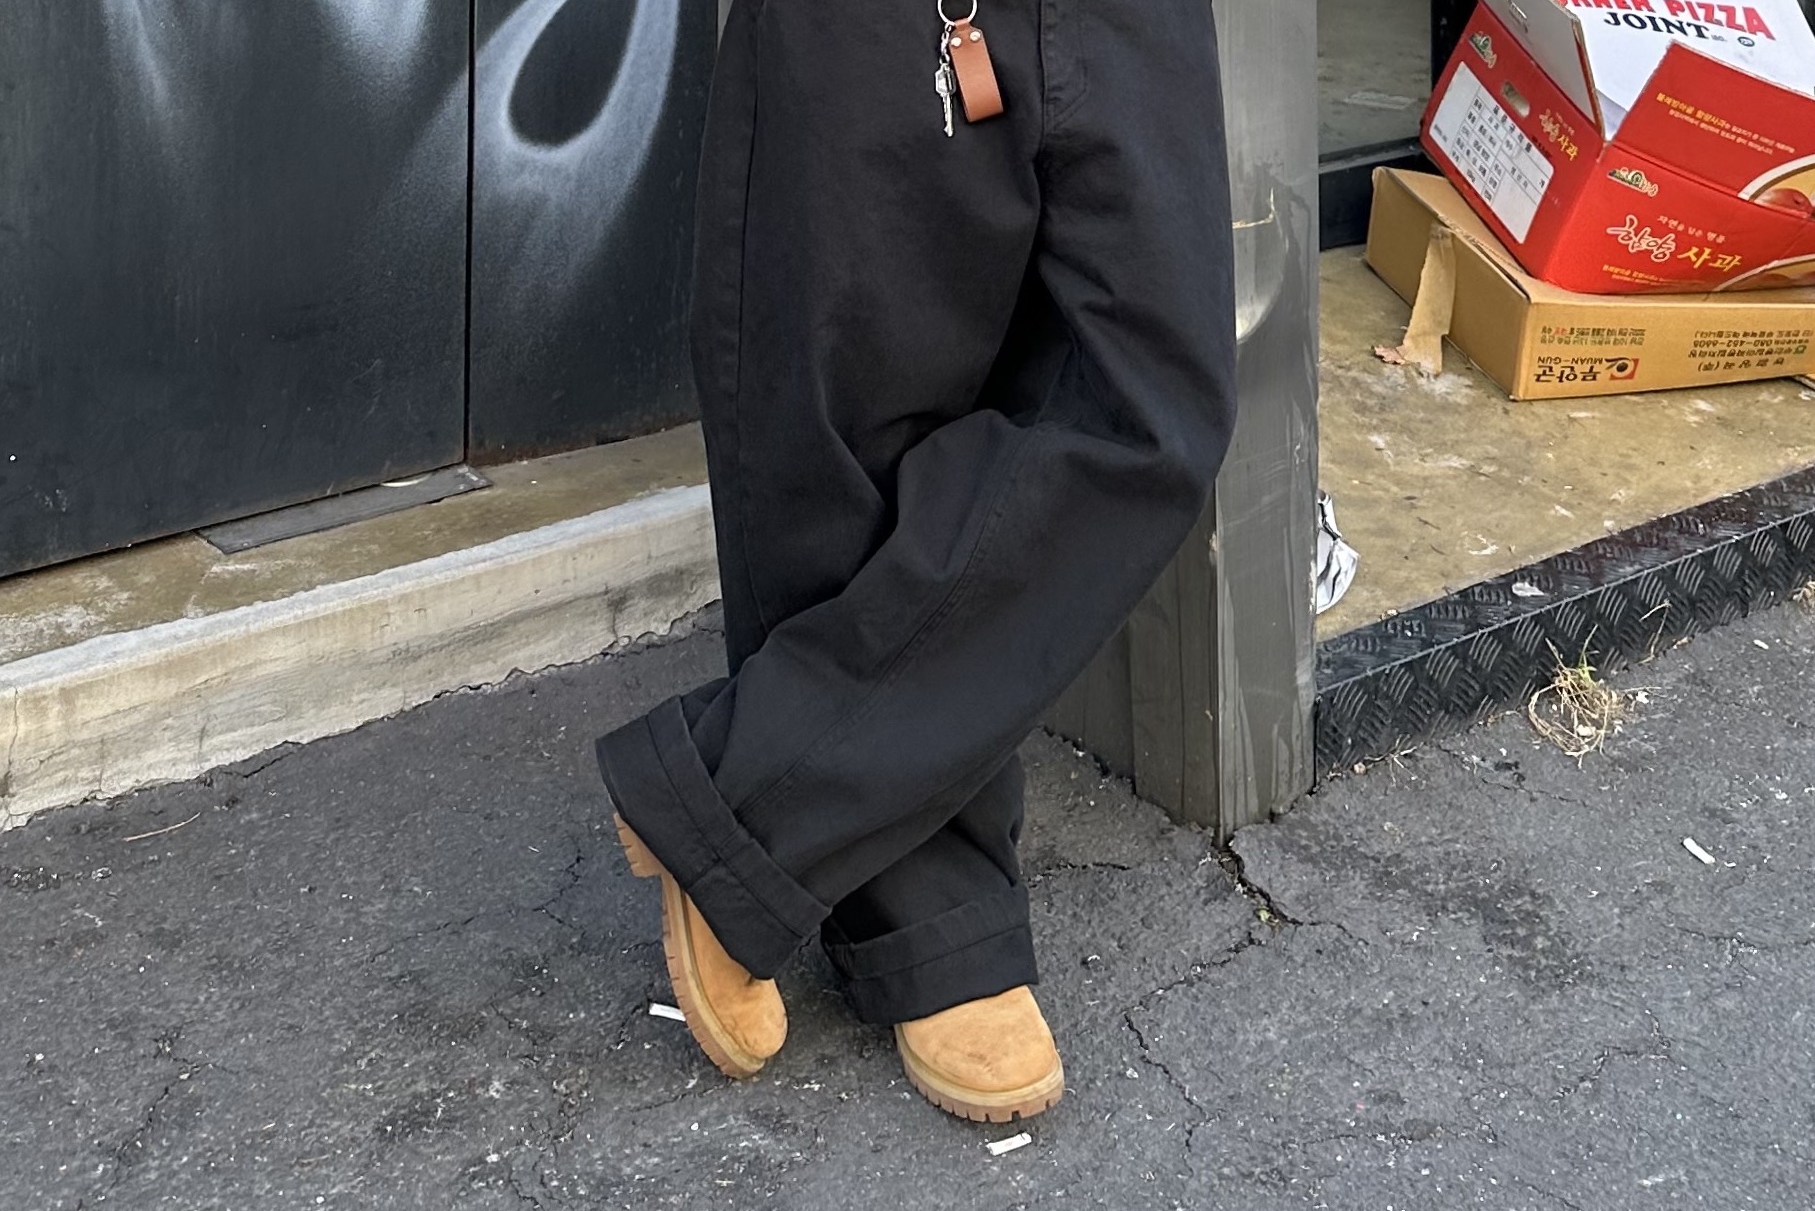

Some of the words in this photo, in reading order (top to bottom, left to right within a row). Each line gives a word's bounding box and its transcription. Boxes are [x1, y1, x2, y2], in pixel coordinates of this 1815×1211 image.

[1604, 11, 1710, 40] JOINT
[1677, 246, 1742, 272] 사과
[1537, 356, 1603, 365] MUAN-GUN
[1533, 365, 1601, 383] 무안군
